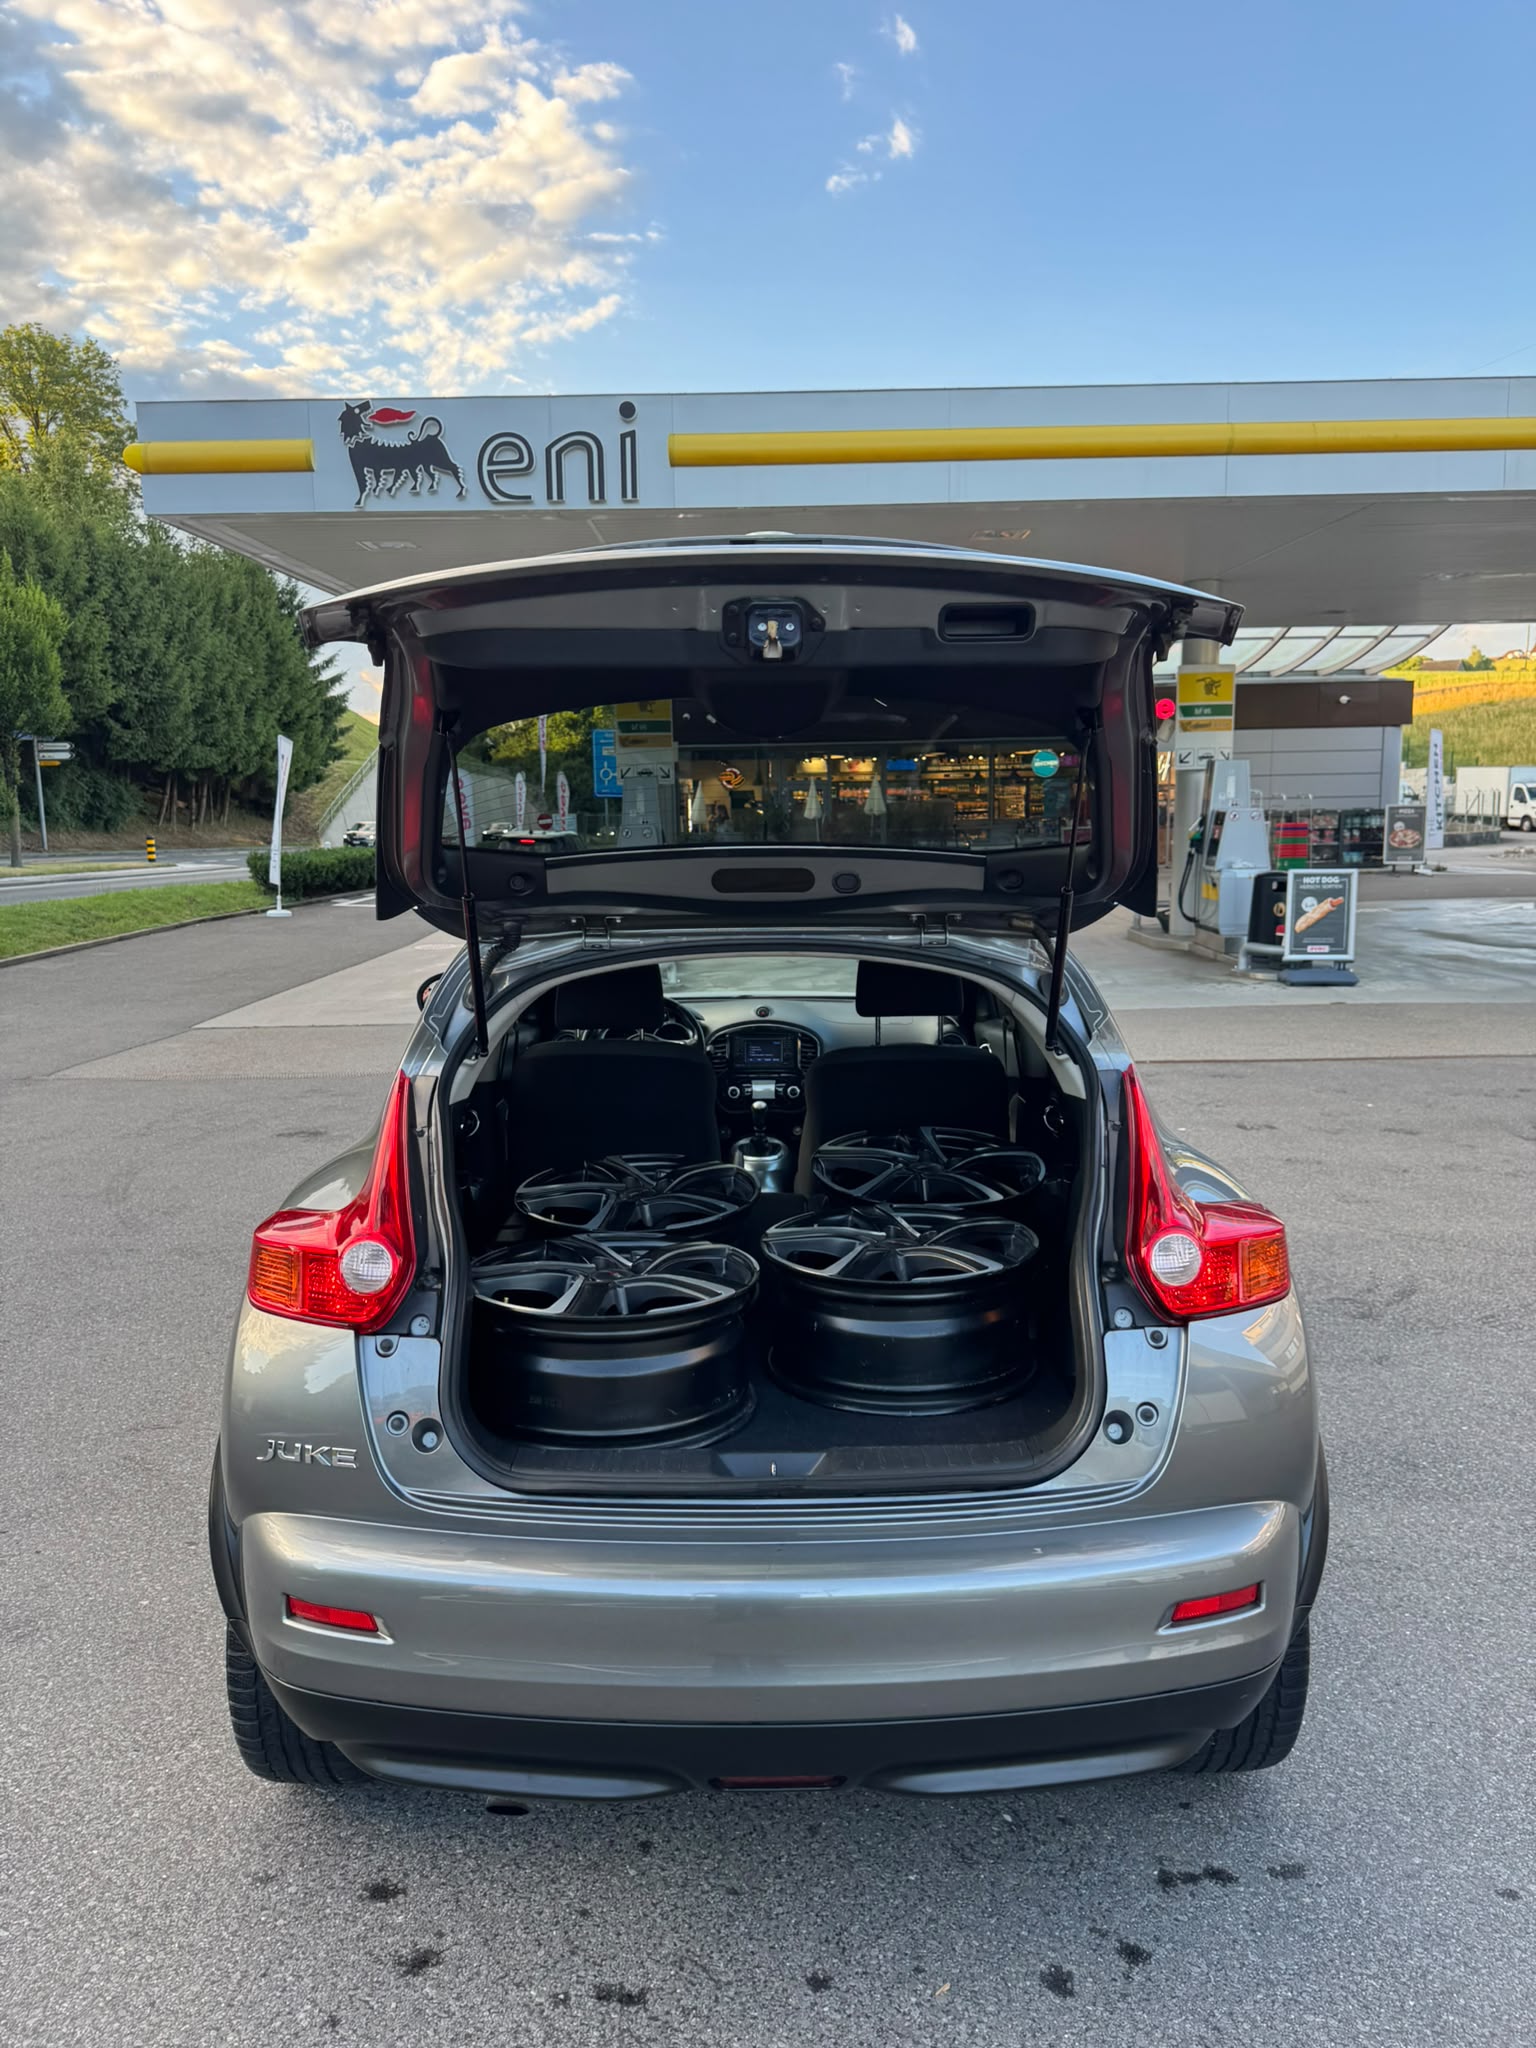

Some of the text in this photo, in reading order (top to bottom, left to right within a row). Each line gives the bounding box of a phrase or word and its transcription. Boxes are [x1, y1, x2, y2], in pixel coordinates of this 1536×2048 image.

[478, 401, 638, 502] eni
[1303, 876, 1320, 884] HOT
[256, 1439, 358, 1469] JUKE
